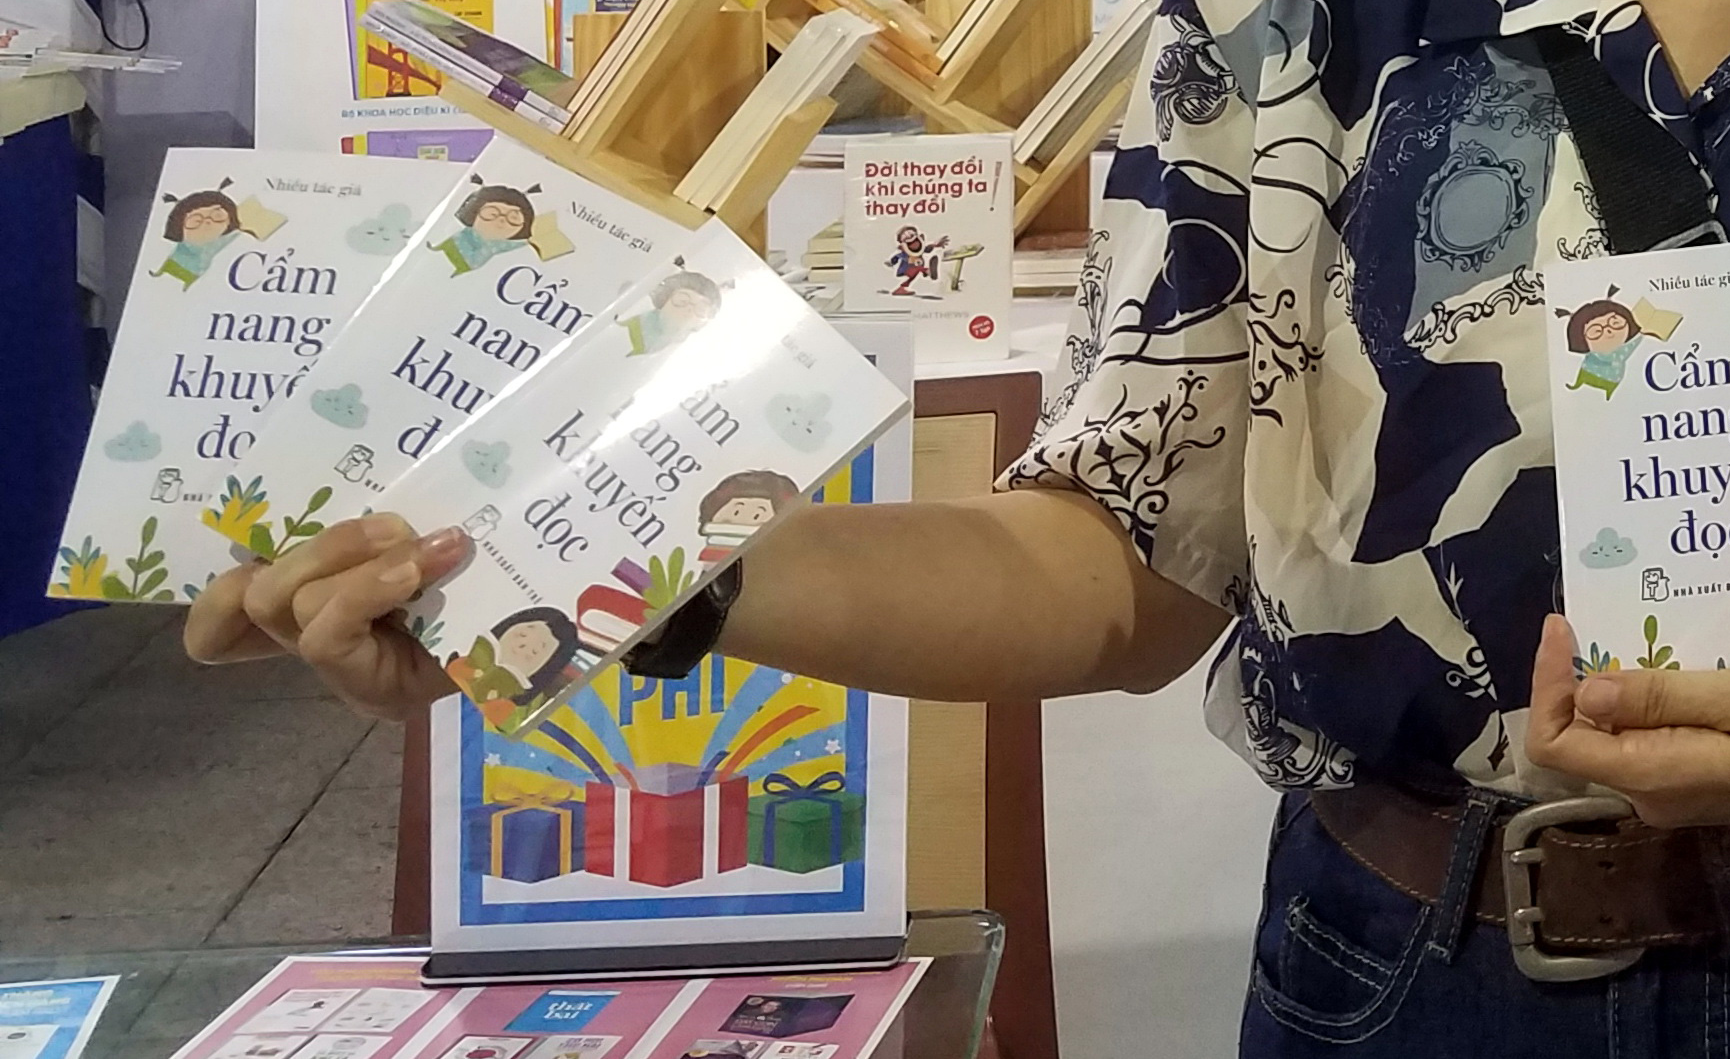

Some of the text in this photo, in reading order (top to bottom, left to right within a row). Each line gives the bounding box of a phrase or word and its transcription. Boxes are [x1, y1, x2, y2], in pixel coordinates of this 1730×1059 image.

[865, 155, 983, 179] Đời thay đổi
[265, 177, 362, 199] Nhiều tác giả
[865, 178, 987, 198] khi chúng ta
[865, 195, 946, 217] thay đổi
[567, 200, 653, 255] Nhiều tác giả
[227, 248, 336, 296] Cẩm
[1648, 276, 1691, 292] Nhiều
[1694, 275, 1715, 288] tác
[206, 311, 332, 357] nang
[451, 309, 542, 375] nan
[524, 493, 588, 562] đọc
[1673, 585, 1693, 599] NHÀ
[1696, 581, 1722, 597] XUẤT
